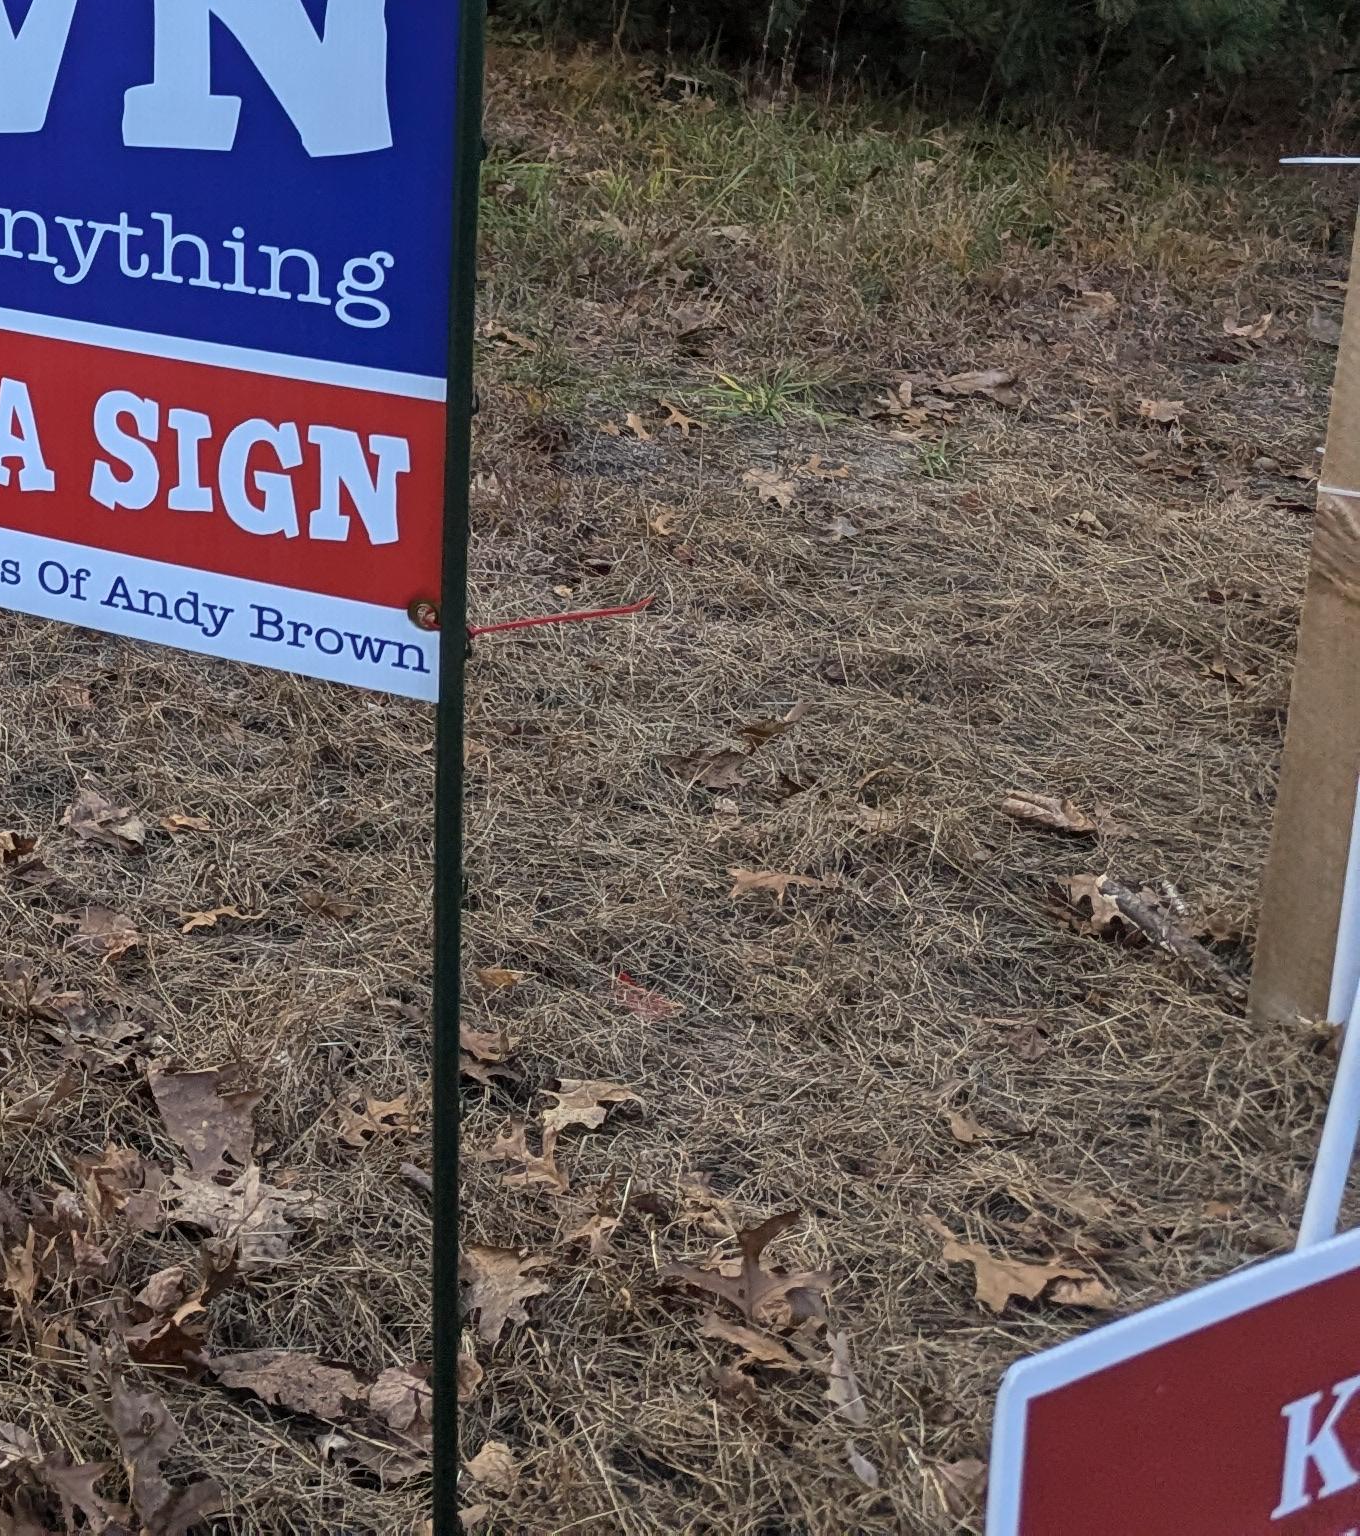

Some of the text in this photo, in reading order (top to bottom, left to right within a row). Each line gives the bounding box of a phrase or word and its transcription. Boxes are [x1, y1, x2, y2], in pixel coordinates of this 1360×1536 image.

[88, 390, 410, 545] SIGN
[38, 560, 91, 602] Of
[100, 577, 234, 638] Andy
[250, 606, 431, 675] Brown
